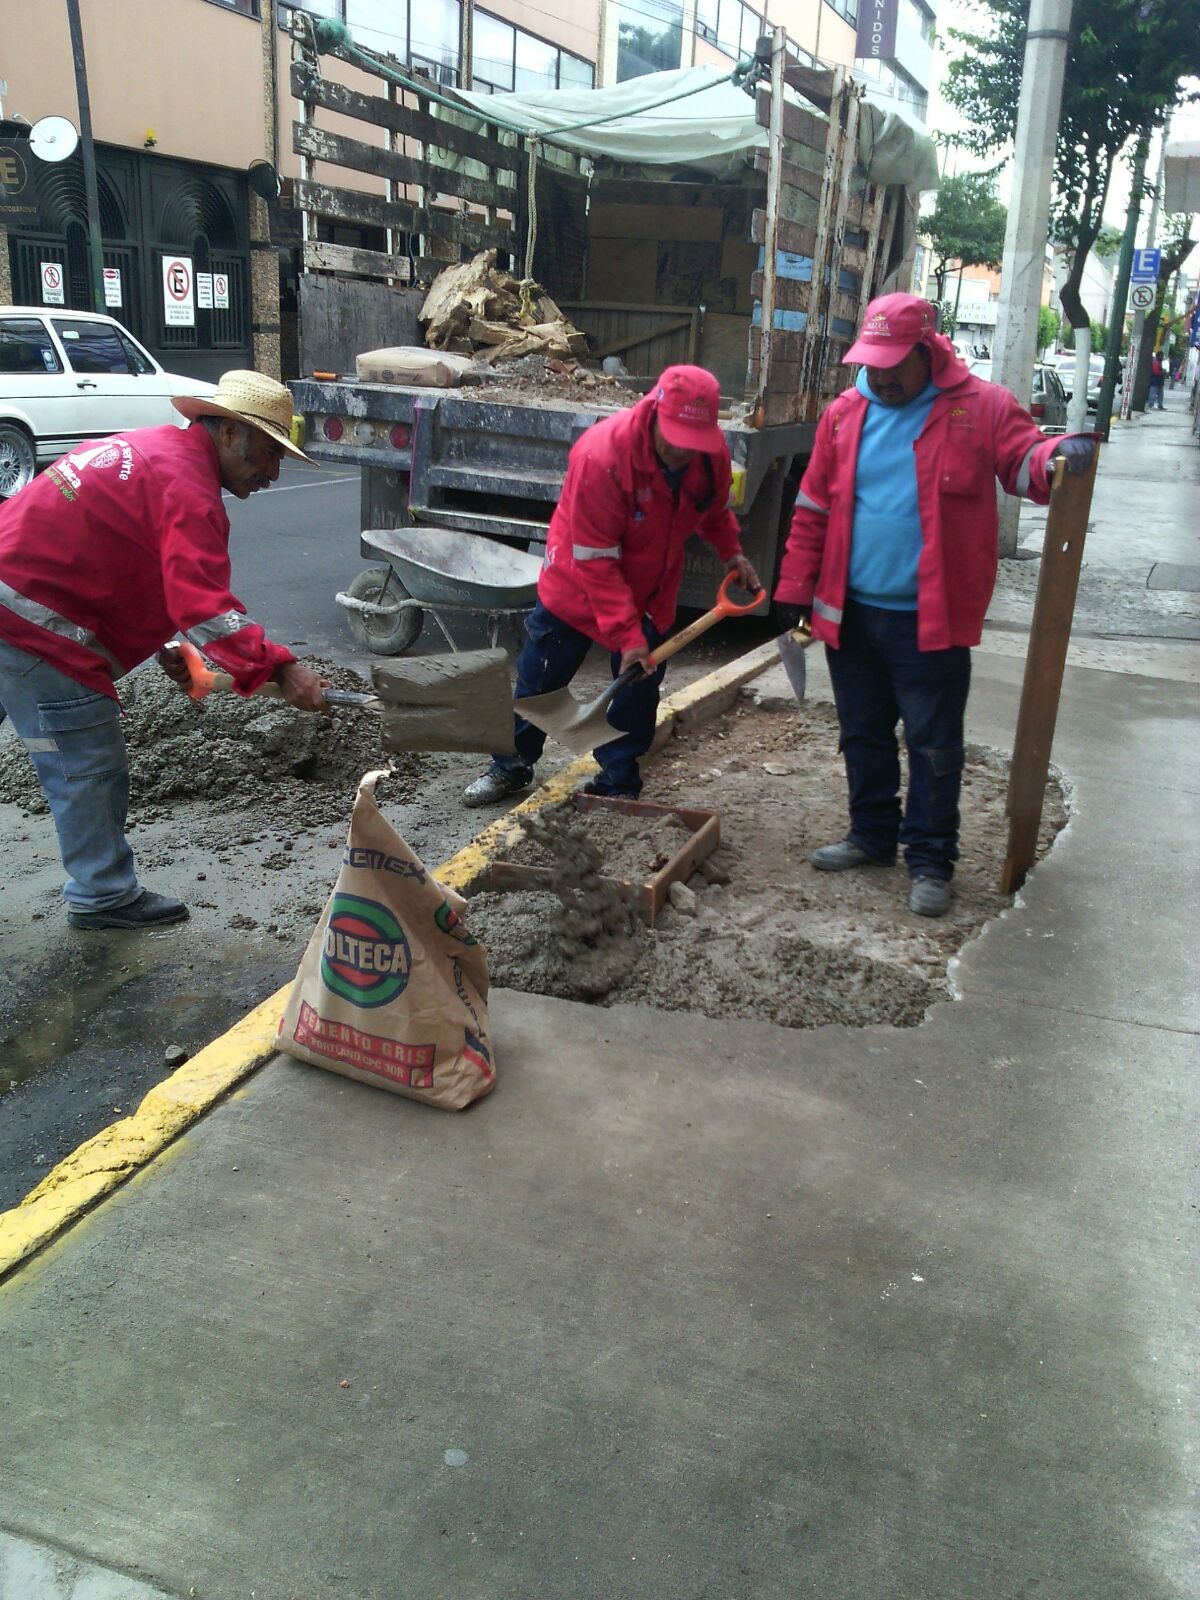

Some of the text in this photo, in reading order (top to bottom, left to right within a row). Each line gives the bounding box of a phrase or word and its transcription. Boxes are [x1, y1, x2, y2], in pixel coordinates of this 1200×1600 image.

[1138, 250, 1156, 272] E
[303, 1006, 428, 1065] CEMENTO GRIS
[311, 1036, 361, 1062] PORTLAND
[361, 1055, 382, 1070] CPC
